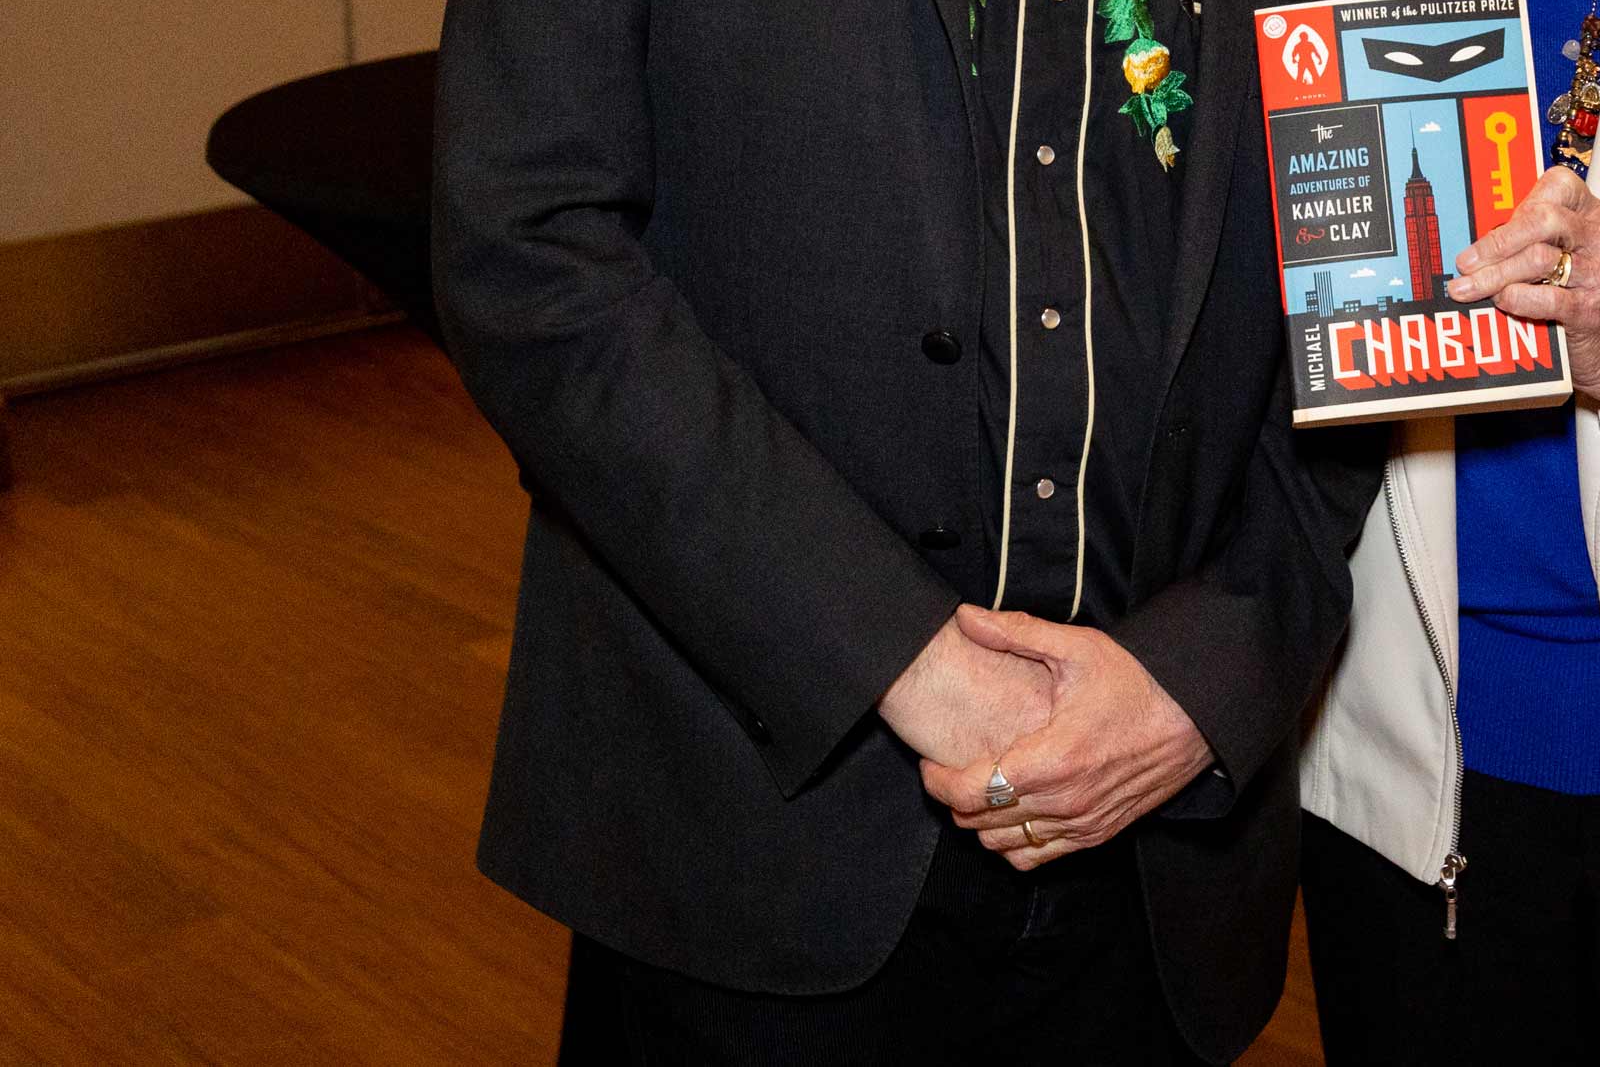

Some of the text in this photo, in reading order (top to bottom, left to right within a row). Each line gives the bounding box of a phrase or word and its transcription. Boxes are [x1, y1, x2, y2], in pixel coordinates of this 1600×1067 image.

[1340, 6, 1388, 23] WINNER
[1391, 5, 1401, 20] of
[1402, 5, 1418, 17] the
[1420, 0, 1476, 16] PULITZER
[1288, 147, 1370, 175] AMAZING
[1290, 175, 1371, 196] ADVENTURES OF
[1292, 195, 1373, 221] KAVALIER
[1295, 221, 1371, 245] & CLAY
[1328, 307, 1540, 380] CHABON
[1304, 323, 1326, 392] MICHAEL
